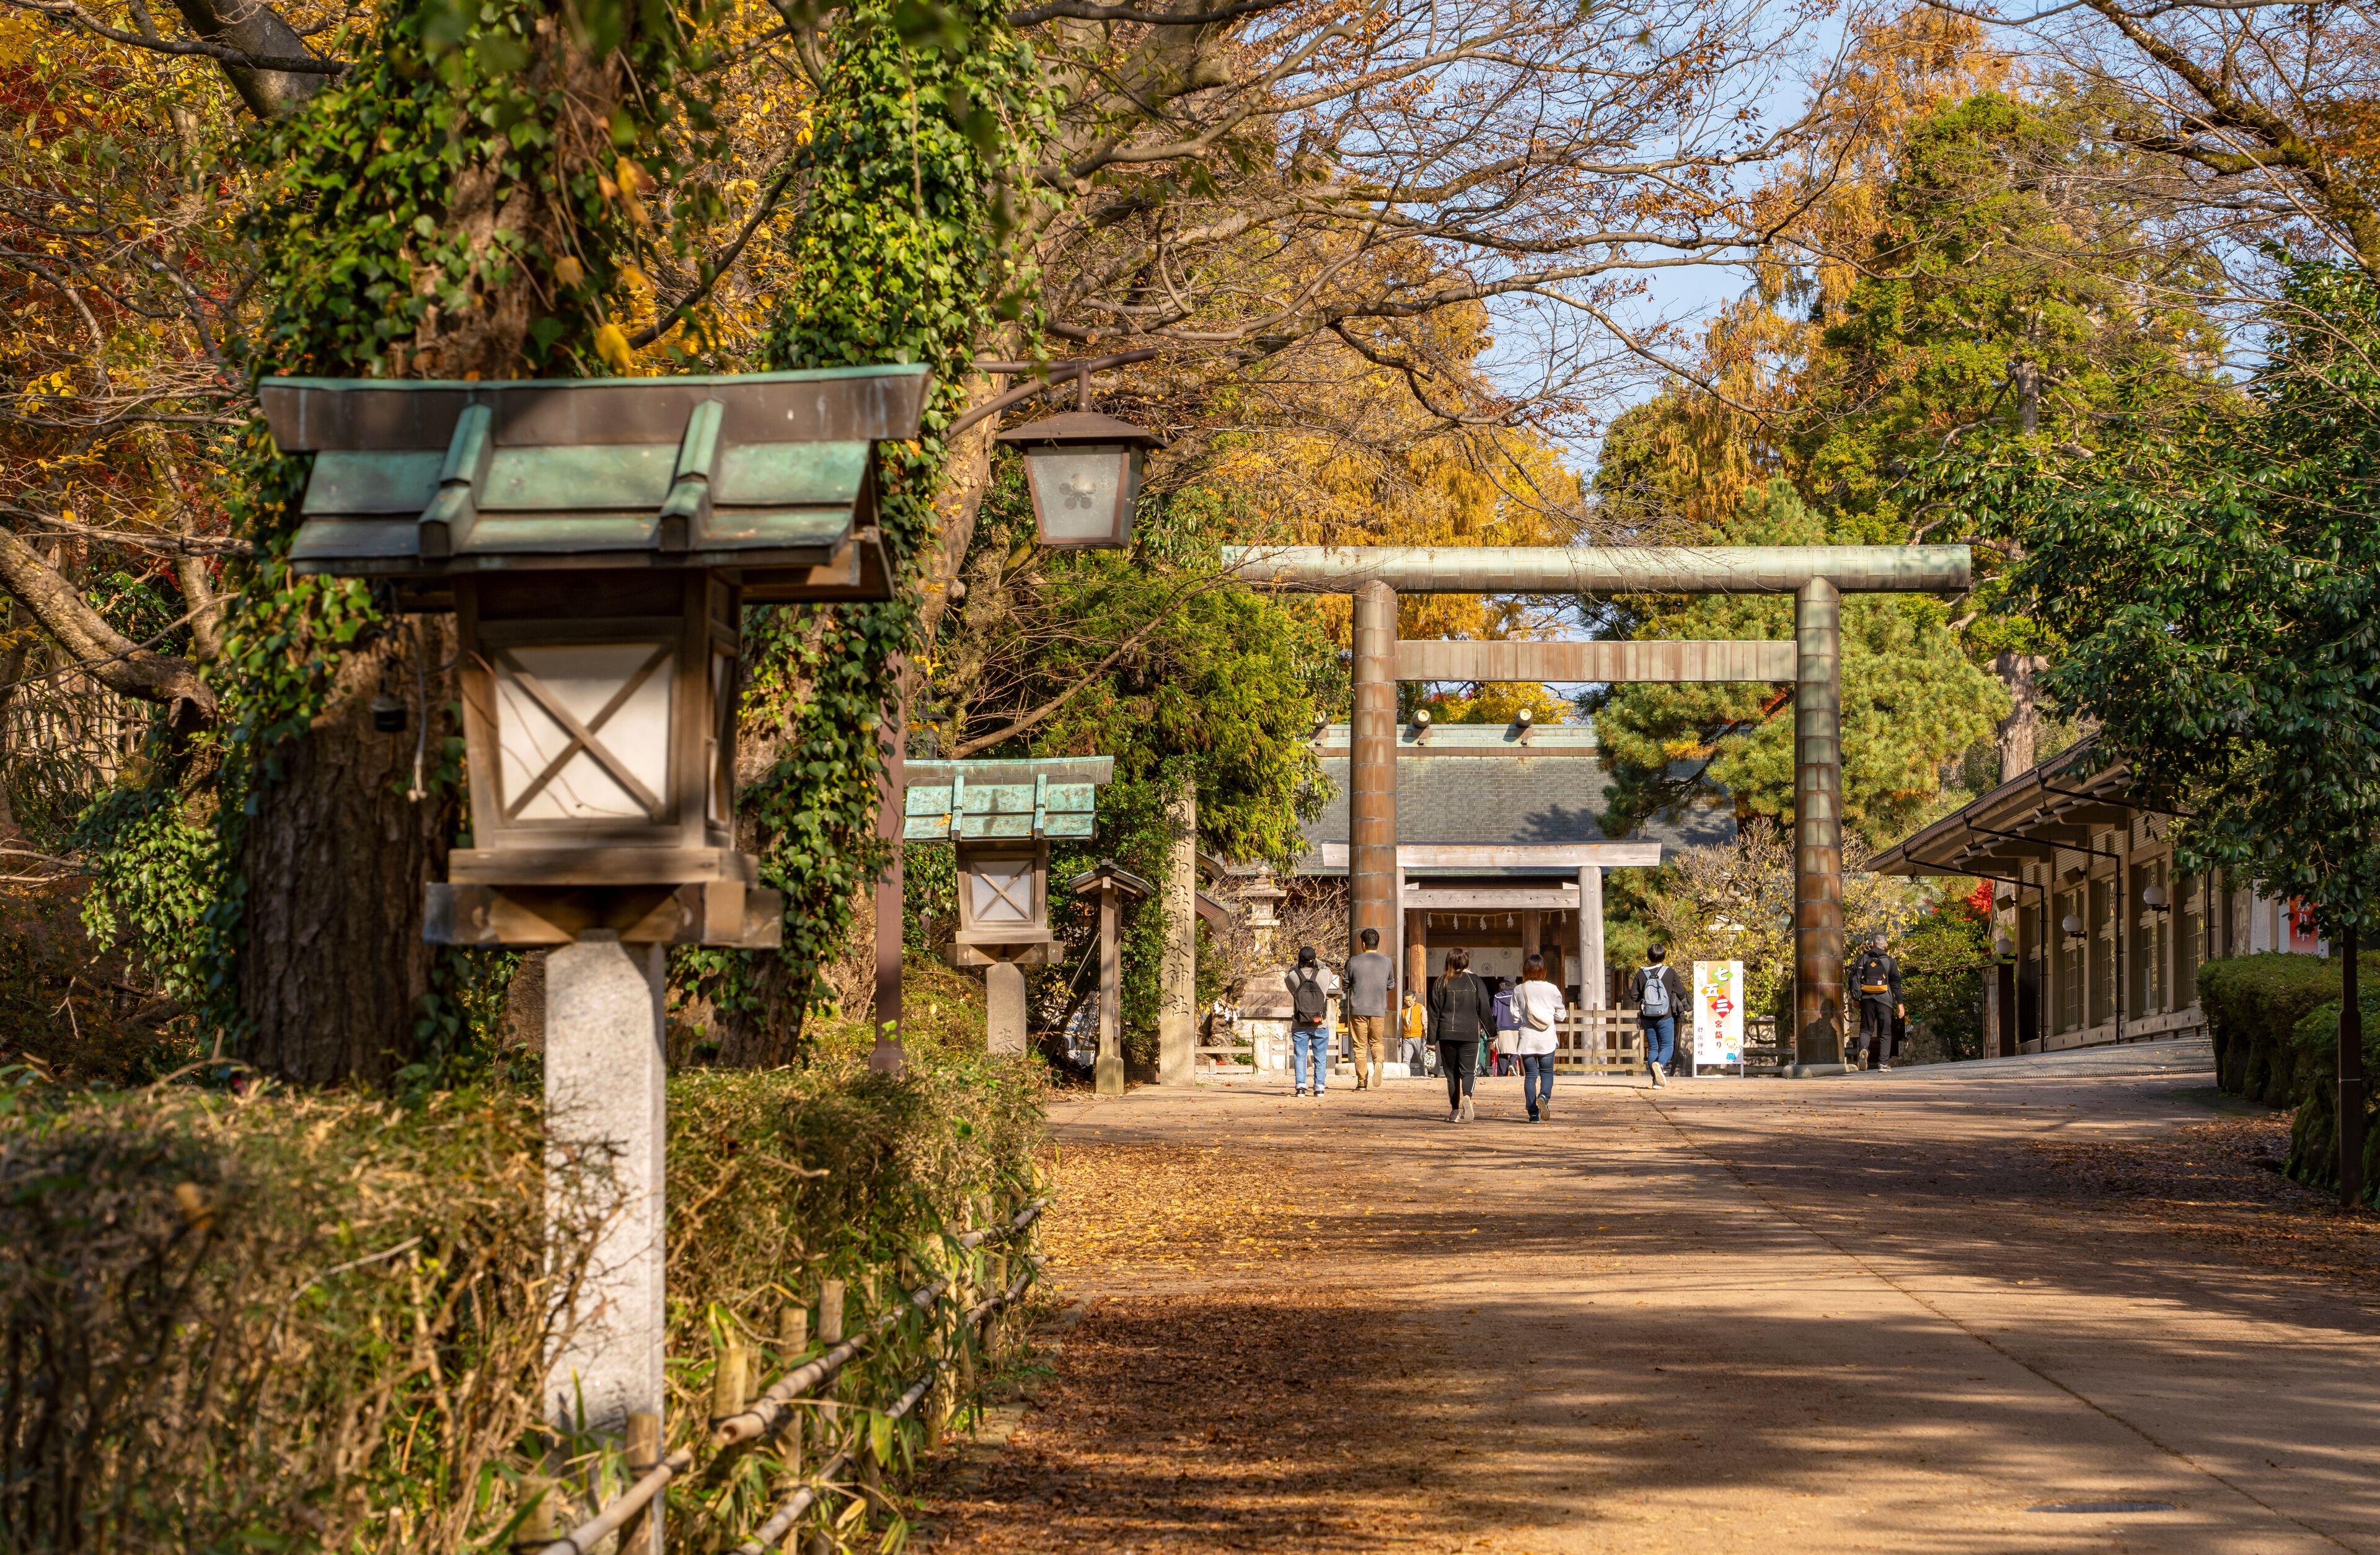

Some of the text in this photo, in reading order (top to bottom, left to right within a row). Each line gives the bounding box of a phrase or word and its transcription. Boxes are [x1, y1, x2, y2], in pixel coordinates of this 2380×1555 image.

[1705, 966, 1730, 1014] 七五三
[1715, 1020, 1723, 1048] 宮詣り
